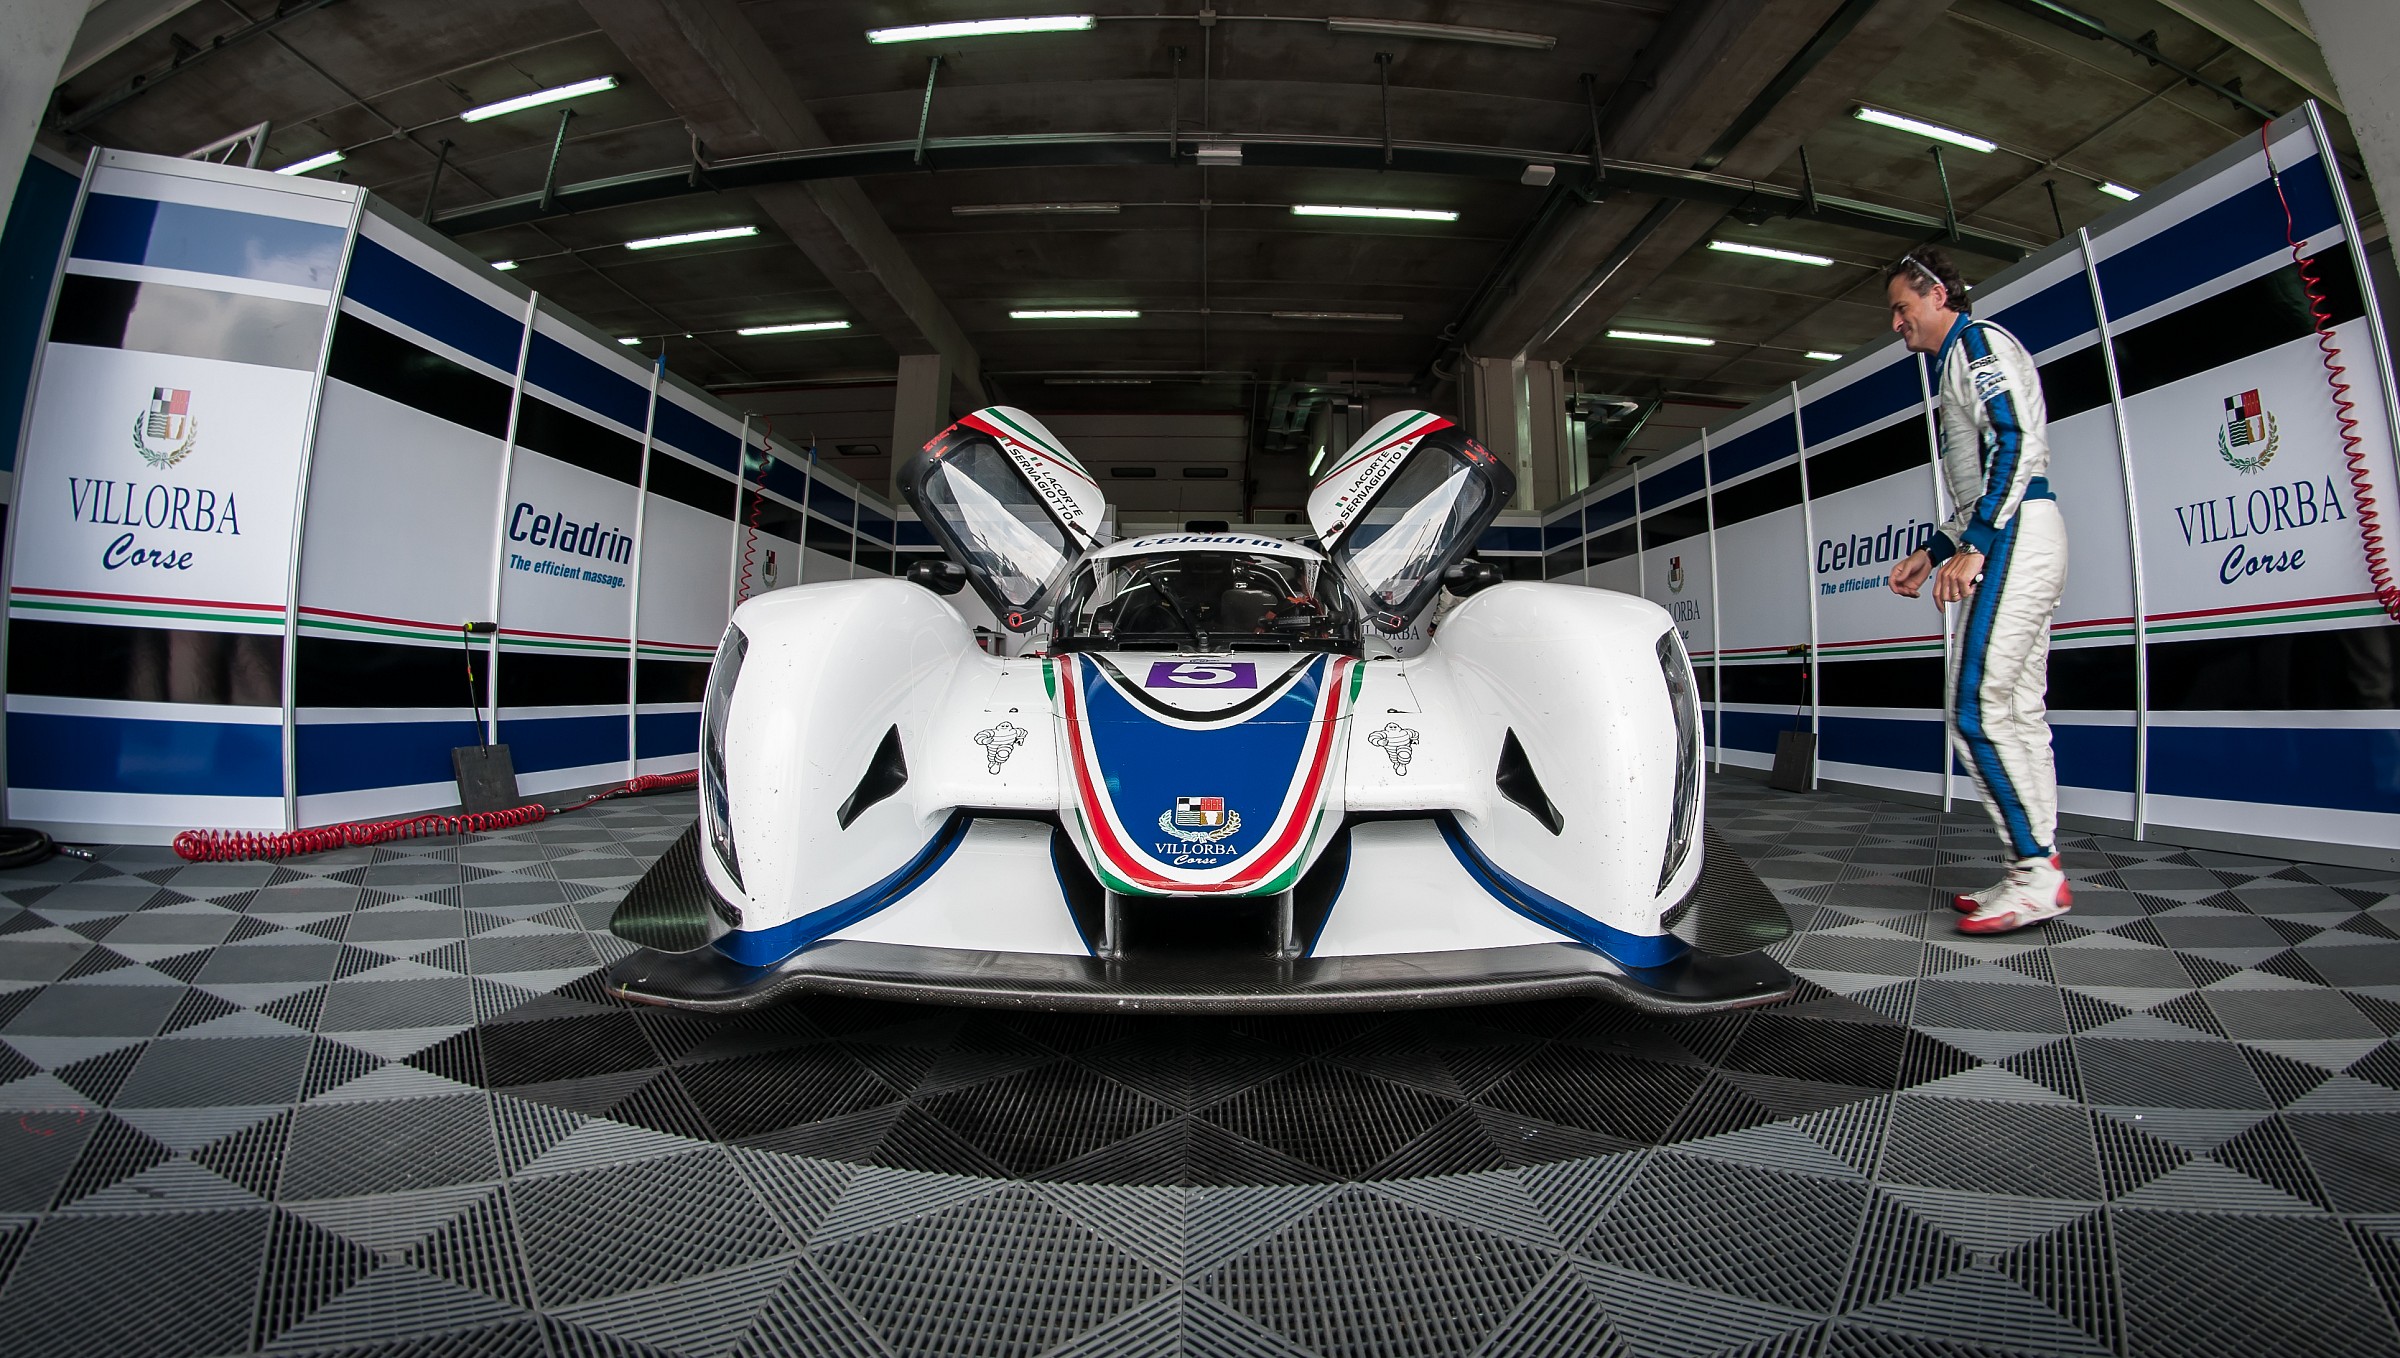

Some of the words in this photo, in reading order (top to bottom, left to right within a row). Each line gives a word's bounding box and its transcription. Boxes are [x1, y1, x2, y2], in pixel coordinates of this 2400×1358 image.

[1466, 438, 1497, 465] PUSH
[1009, 448, 1074, 523] SERNAGIOTTO
[1341, 452, 1401, 520] SERNAGIOTTO
[1349, 450, 1390, 493] LACORTE
[69, 477, 241, 535] VILLORBA
[1042, 471, 1083, 516] LACORTE
[2175, 475, 2347, 546] VILLORBA
[102, 533, 193, 570] Corse
[509, 502, 633, 564] Celadrin
[1133, 536, 1283, 549] Celadrin
[510, 554, 531, 571] The
[534, 560, 580, 580] efficient
[582, 570, 625, 588] massage.
[2219, 544, 2306, 584] Corse
[1821, 583, 1836, 595] The
[1839, 575, 1880, 593] efficient
[1167, 663, 1237, 685] 5
[1155, 843, 1237, 855] VILLORBA
[1174, 854, 1217, 865] Corse
